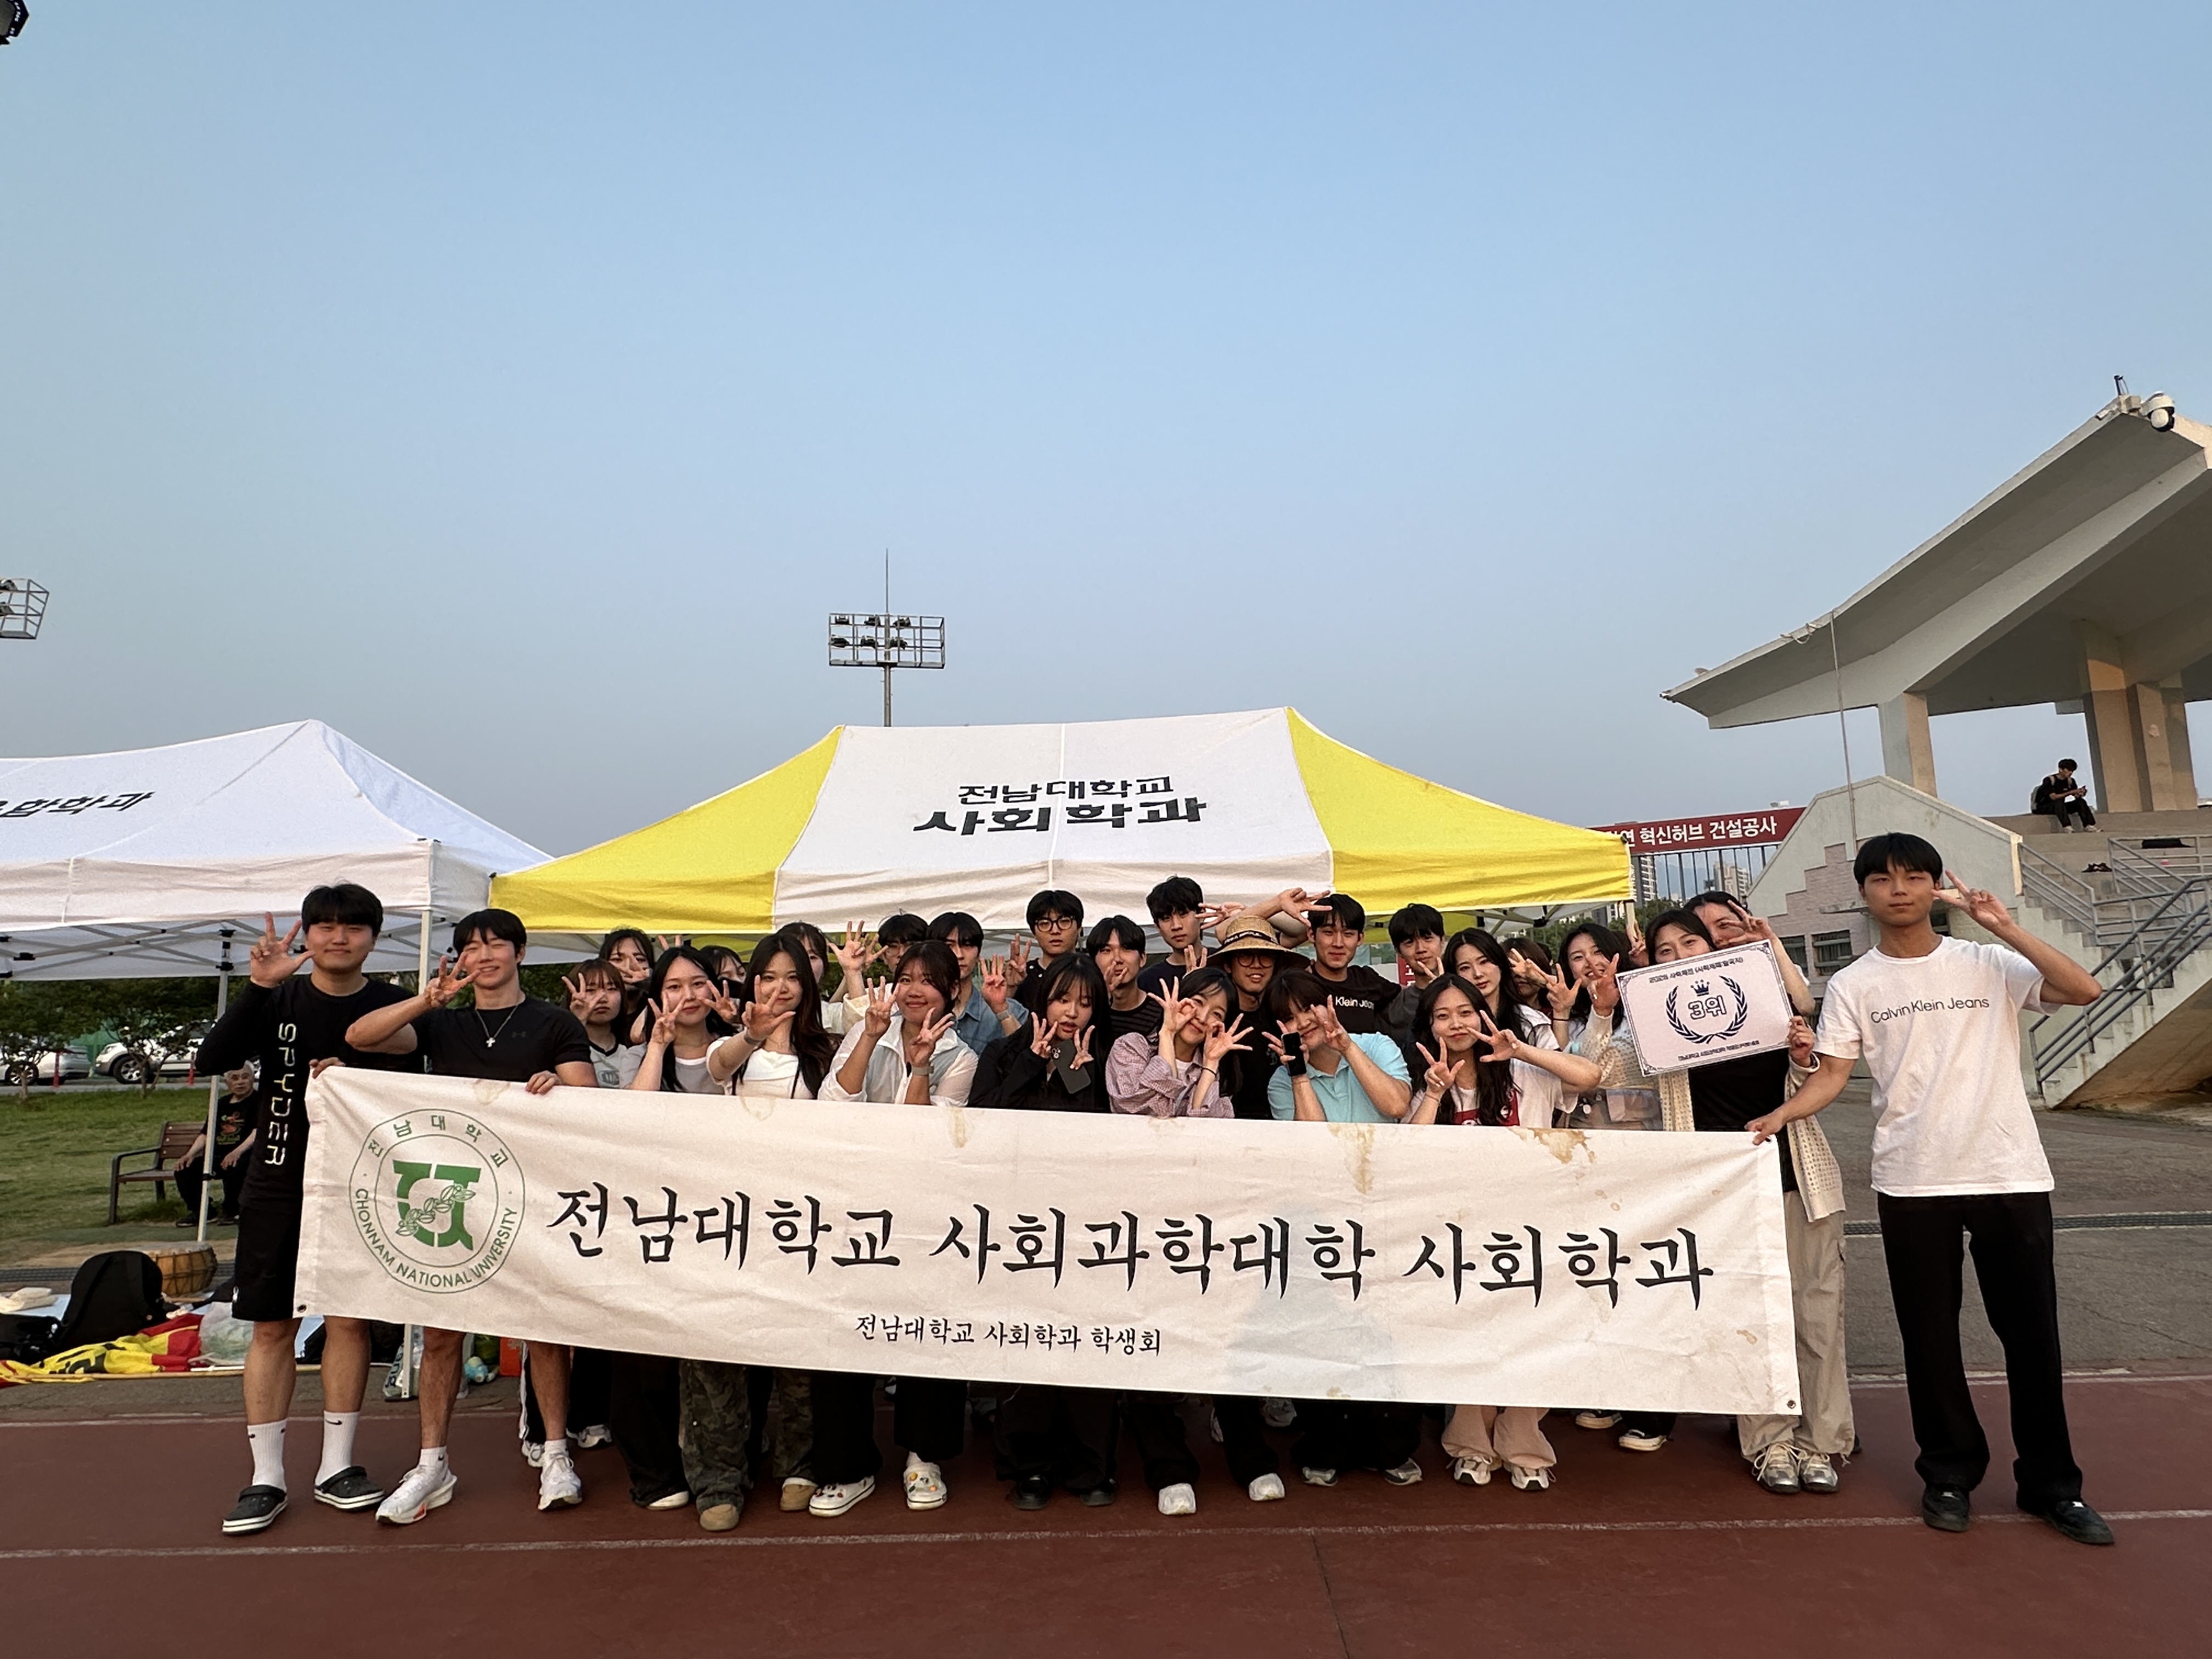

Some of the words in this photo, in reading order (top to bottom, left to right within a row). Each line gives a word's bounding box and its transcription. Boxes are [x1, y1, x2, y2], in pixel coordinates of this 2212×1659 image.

[0, 792, 155, 817] 합학과
[958, 776, 1174, 805] 전남대학교
[913, 797, 1207, 836] 사회학과
[1639, 823, 1704, 845] 혁신허브
[1709, 815, 1778, 840] 건설공사
[1335, 996, 1358, 1007] Klein
[1688, 995, 1727, 1020] 3위
[1871, 1005, 1911, 1024] Calvin
[1910, 999, 1945, 1013] Klein
[1947, 997, 1990, 1009] Jeans
[264, 1022, 297, 1166] SPYDER
[368, 1114, 509, 1167] 전남대학교
[356, 1188, 396, 1266] CHONNAM
[396, 1262, 472, 1288] NATIONAL
[471, 1207, 518, 1279] UNIVERSITY
[546, 1181, 901, 1276] 전남대학교
[929, 1203, 1376, 1301] 사회과학대학
[1402, 1222, 1714, 1311] 사회학과
[854, 1313, 975, 1345] 전남대학교
[983, 1321, 1082, 1353] 사회학과
[1090, 1326, 1161, 1357] 학생회
